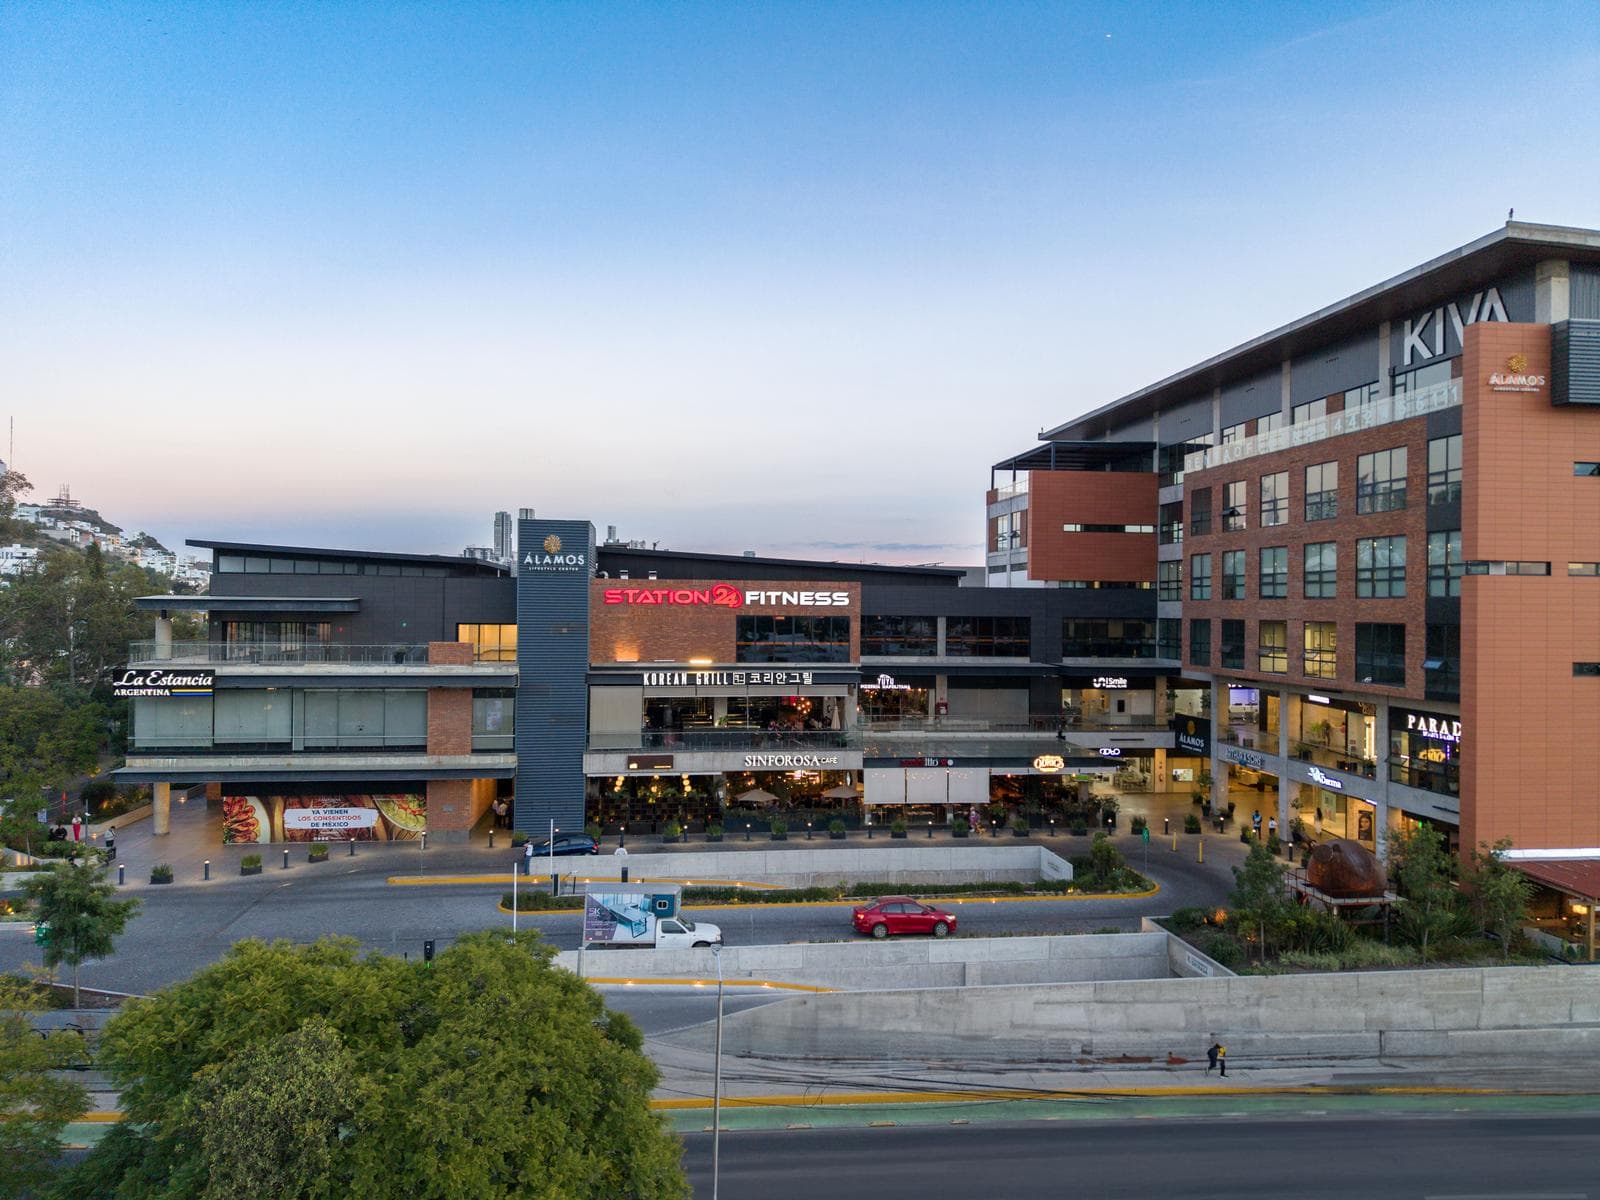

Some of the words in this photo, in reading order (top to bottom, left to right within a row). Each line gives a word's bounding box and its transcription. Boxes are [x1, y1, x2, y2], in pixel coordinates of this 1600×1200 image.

[1403, 287, 1510, 366] KIVA
[523, 551, 585, 565] ÁLAMOS
[604, 589, 710, 604] STATION
[712, 587, 739, 608] 24
[745, 591, 850, 606] FITNESS
[113, 670, 144, 686] La
[145, 670, 213, 686] Estancia
[643, 672, 688, 686] KOREAN
[696, 672, 729, 685] GRILL
[113, 688, 171, 696] ARGENTINA
[744, 755, 820, 767] SINFOROSA
